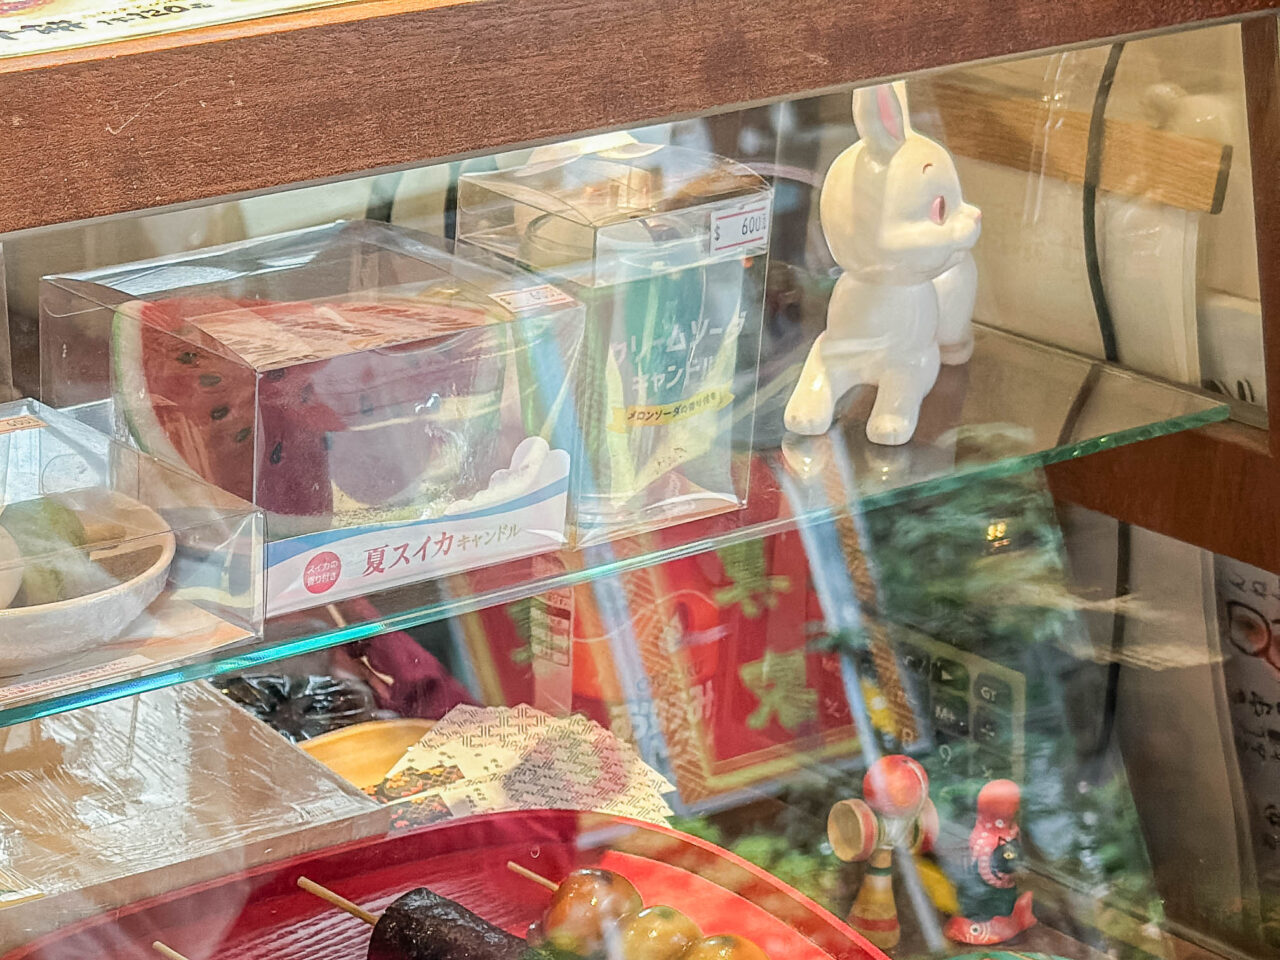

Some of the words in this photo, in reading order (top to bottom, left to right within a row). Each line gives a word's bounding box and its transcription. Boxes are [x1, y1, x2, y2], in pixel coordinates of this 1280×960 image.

[362, 531, 454, 578] 夏スイカ
[457, 523, 520, 551] キャンドル
